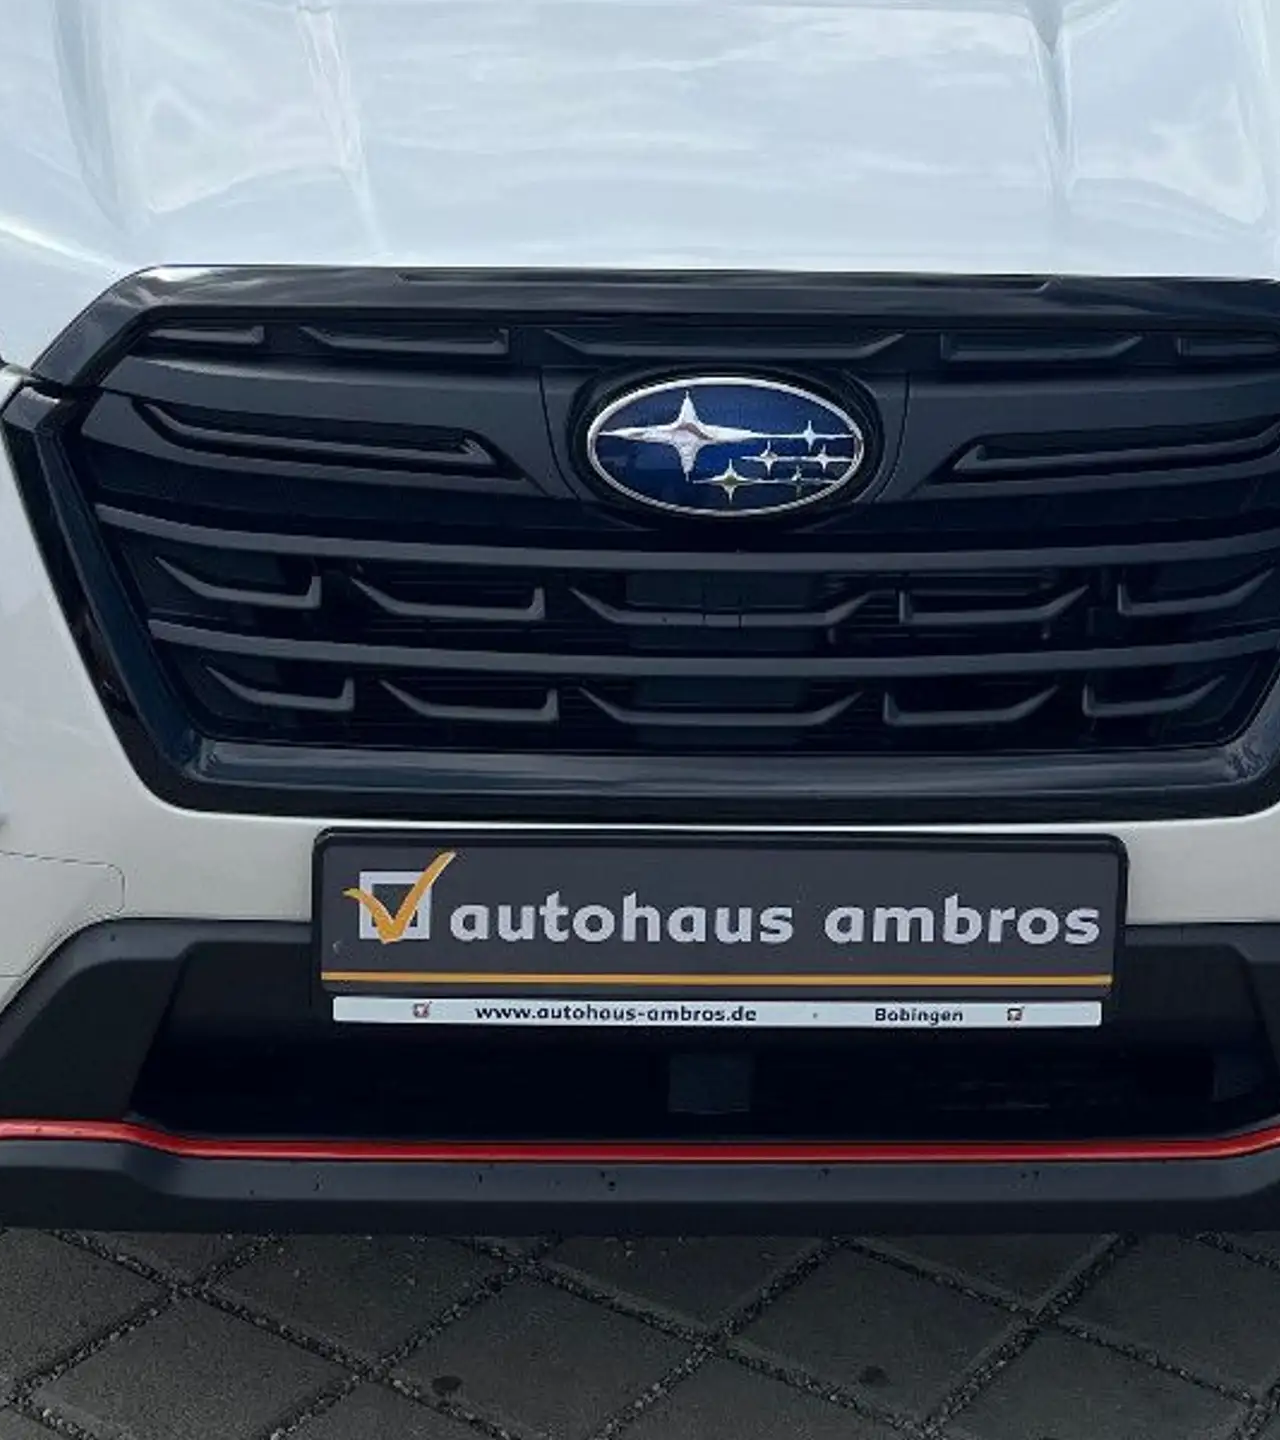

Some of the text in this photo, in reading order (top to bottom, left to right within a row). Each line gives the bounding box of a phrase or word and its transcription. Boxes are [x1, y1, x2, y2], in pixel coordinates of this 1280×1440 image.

[449, 890, 1100, 945] autohaus ambros
[475, 1003, 757, 1022] www.autohaus-ambros.de
